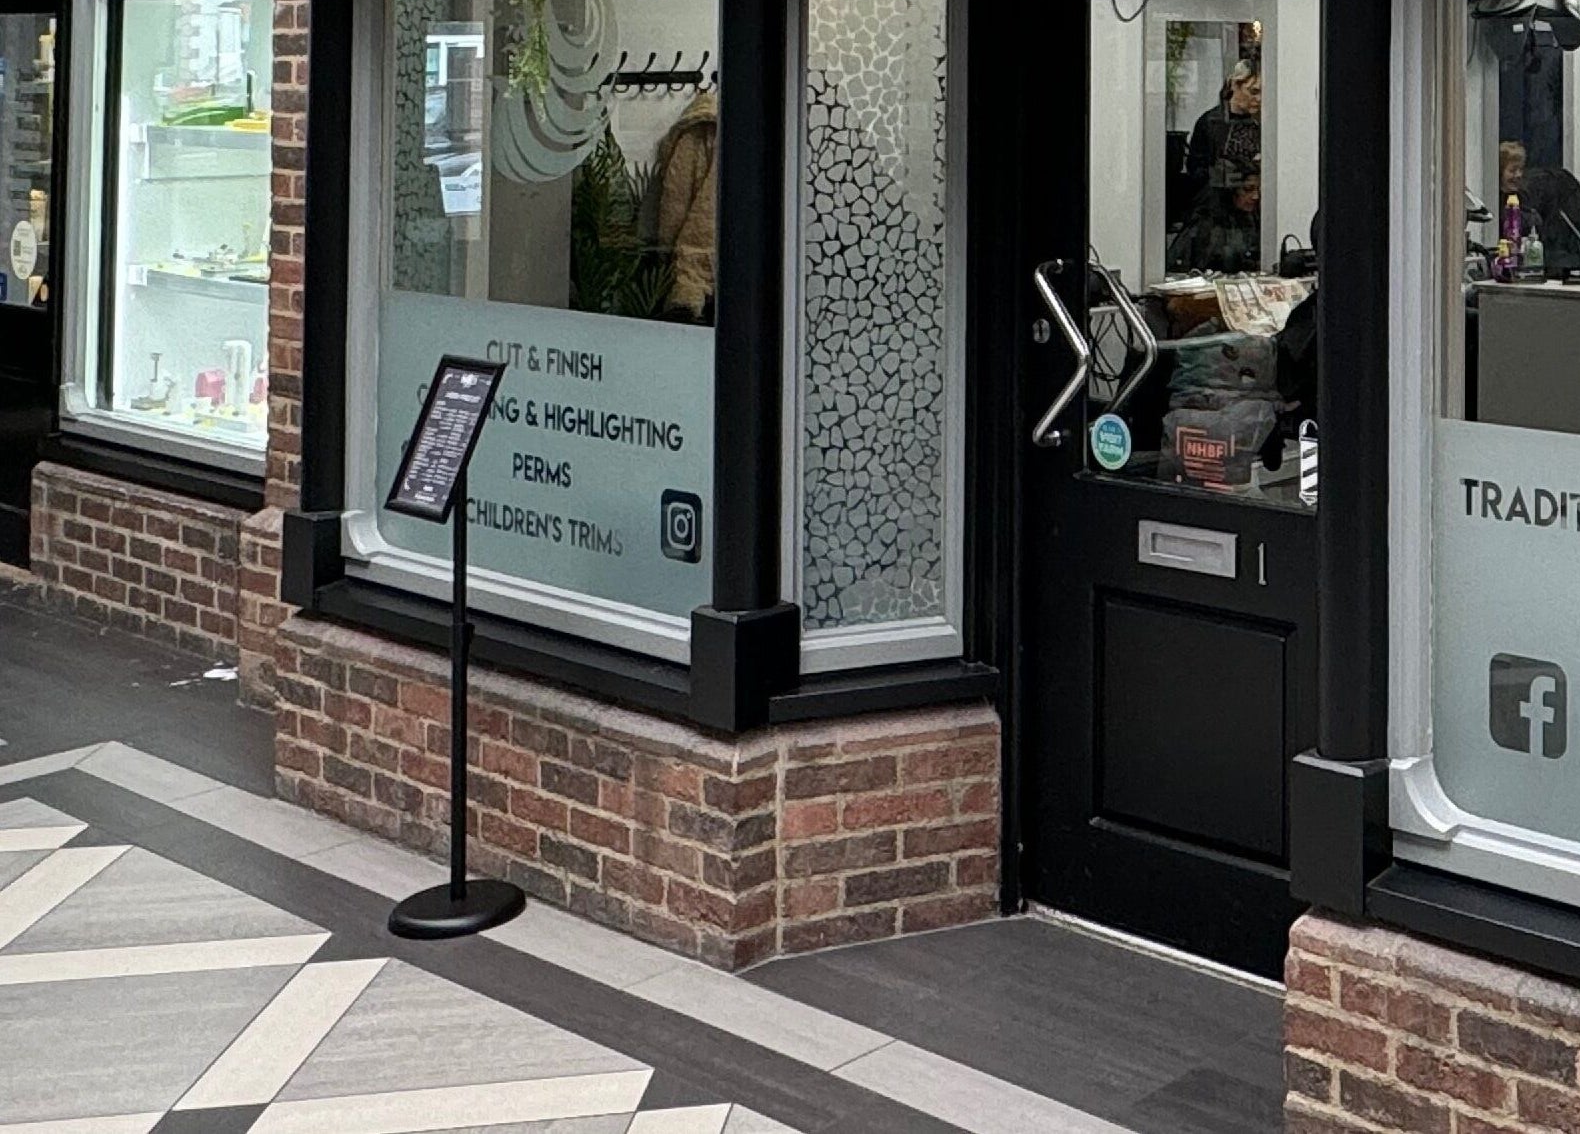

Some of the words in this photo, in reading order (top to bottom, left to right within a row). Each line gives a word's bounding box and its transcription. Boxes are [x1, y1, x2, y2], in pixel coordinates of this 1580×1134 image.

[486, 340, 523, 368] CUT
[527, 345, 541, 371] &
[546, 347, 602, 381] FINISH
[525, 401, 539, 427] &
[544, 402, 684, 452] HIGHLIGHTING
[512, 452, 572, 488] PERMS
[466, 497, 562, 543] CHILDREN'S
[568, 518, 623, 557] TRIMS
